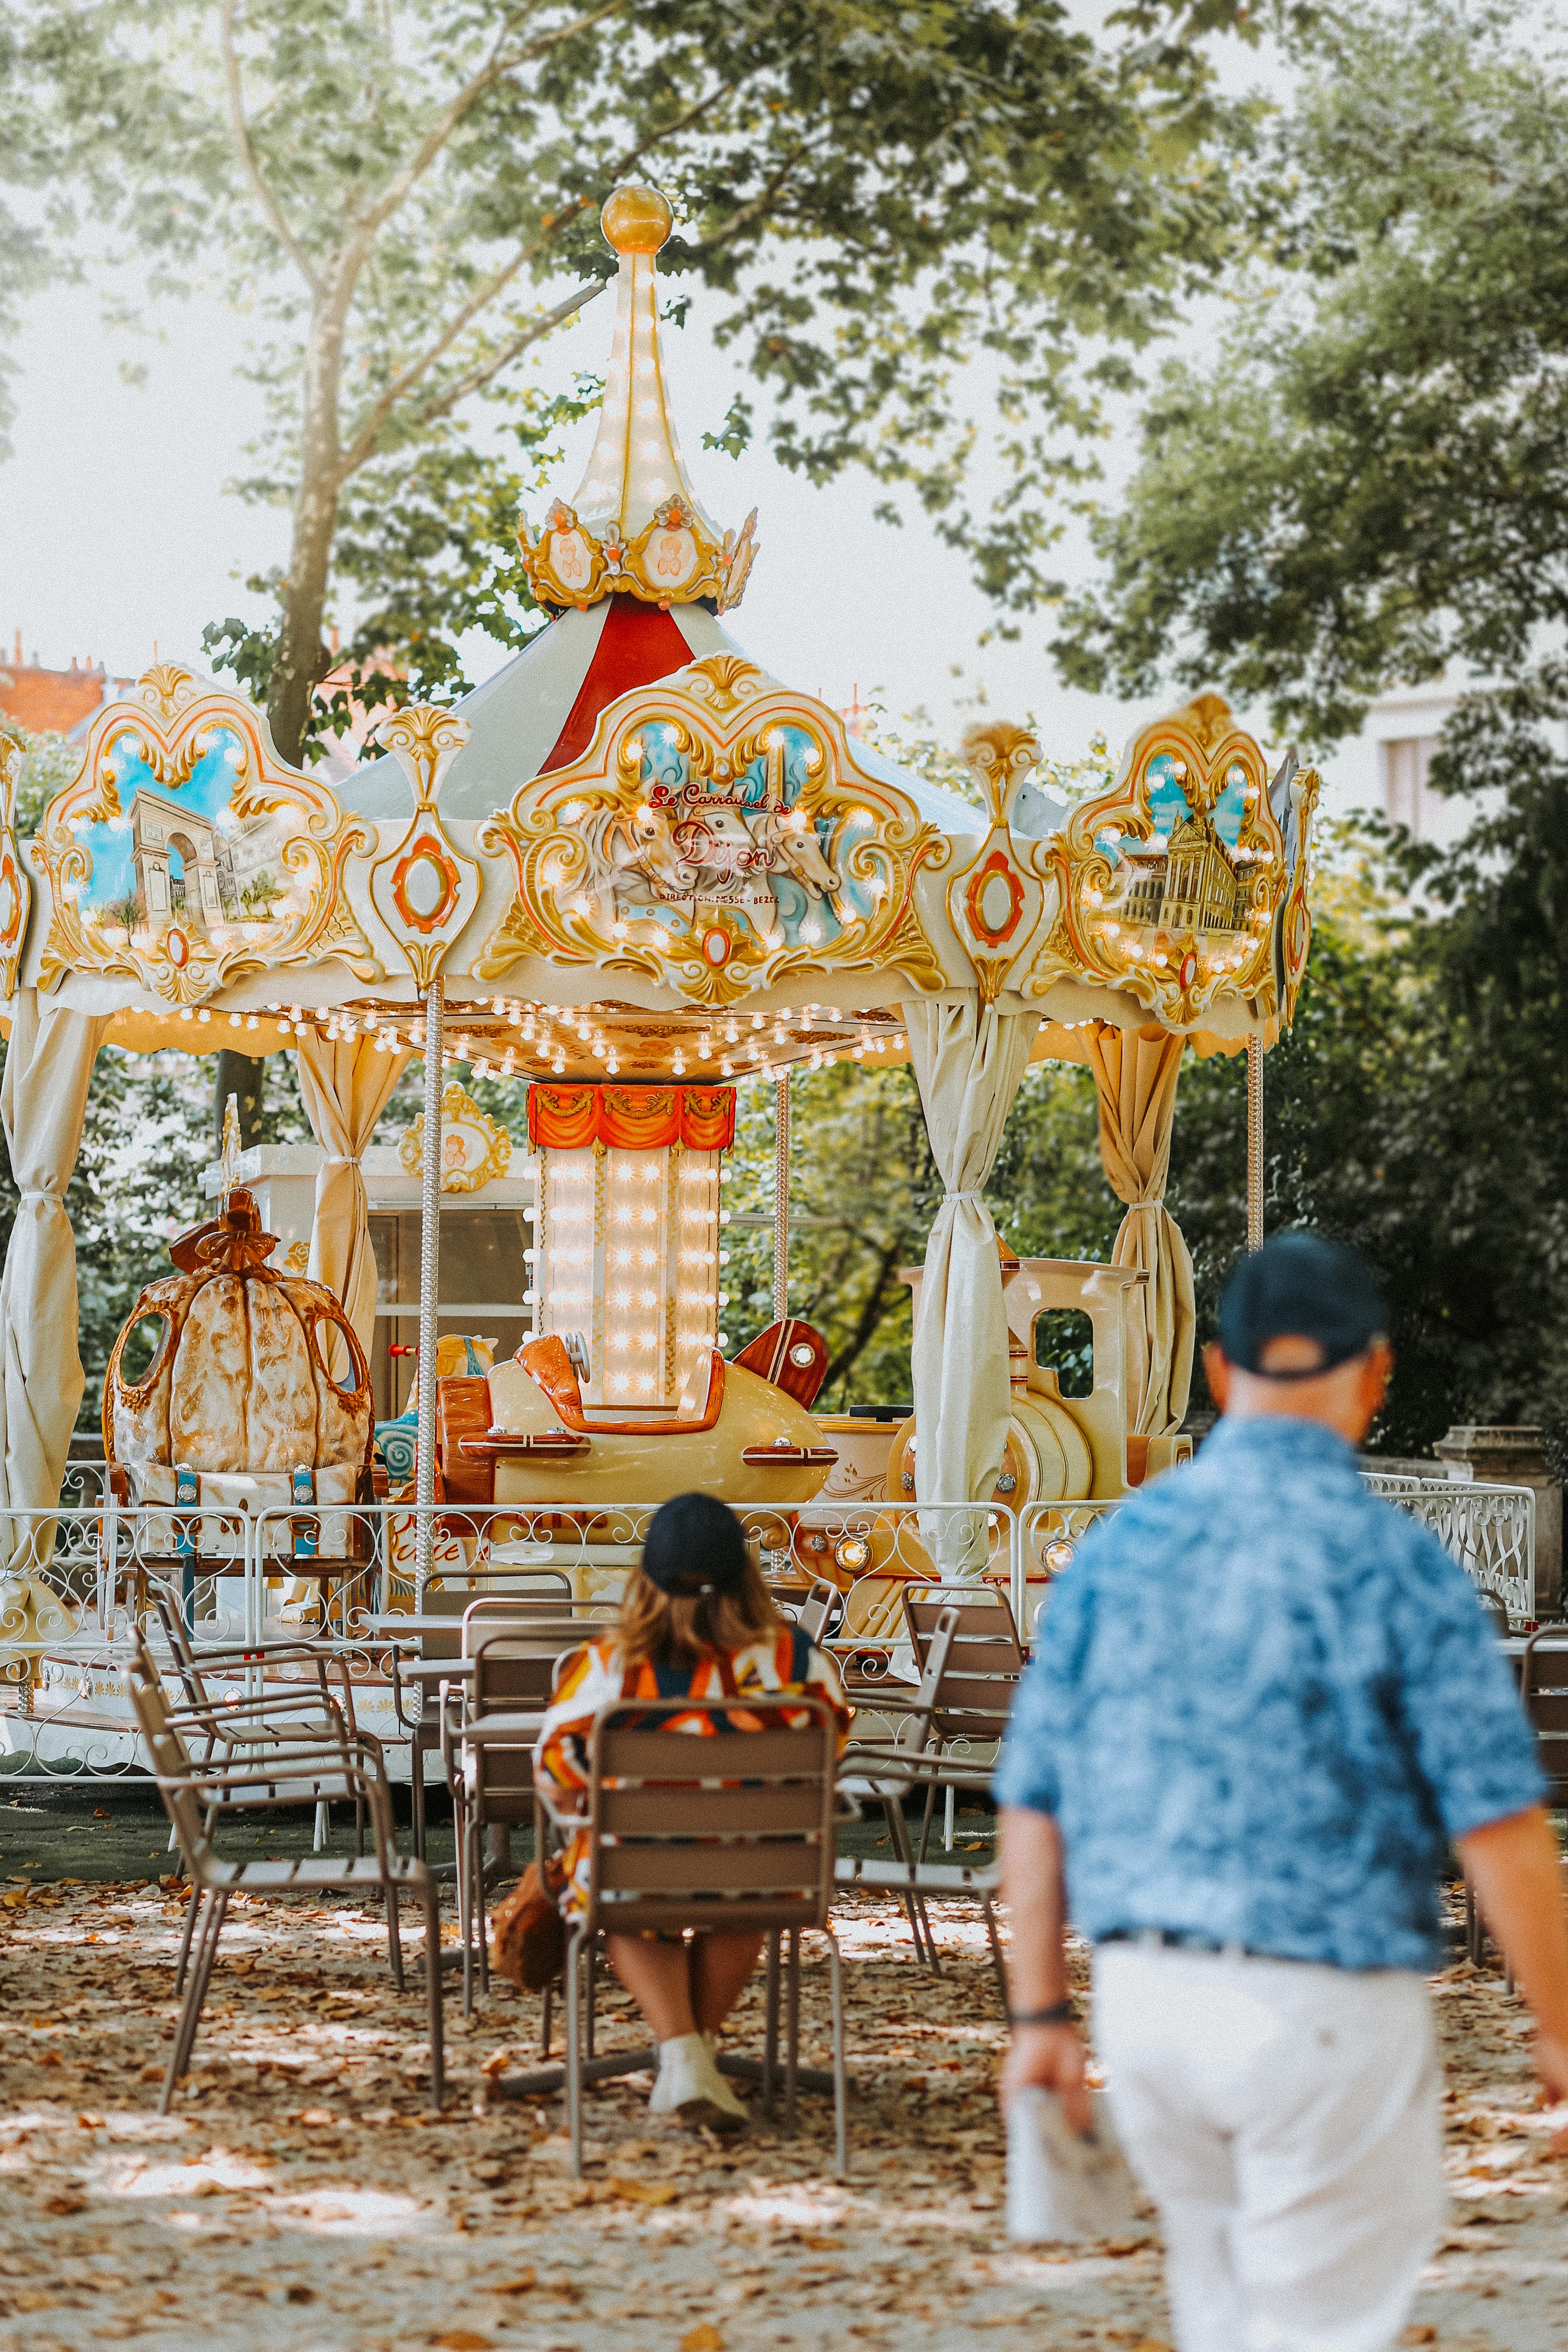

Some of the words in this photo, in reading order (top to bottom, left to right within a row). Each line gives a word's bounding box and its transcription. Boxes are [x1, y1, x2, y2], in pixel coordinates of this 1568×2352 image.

[648, 785, 677, 808] Le
[684, 783, 770, 809] Carrousel
[773, 798, 792, 814] de
[672, 821, 774, 883] Dijon
